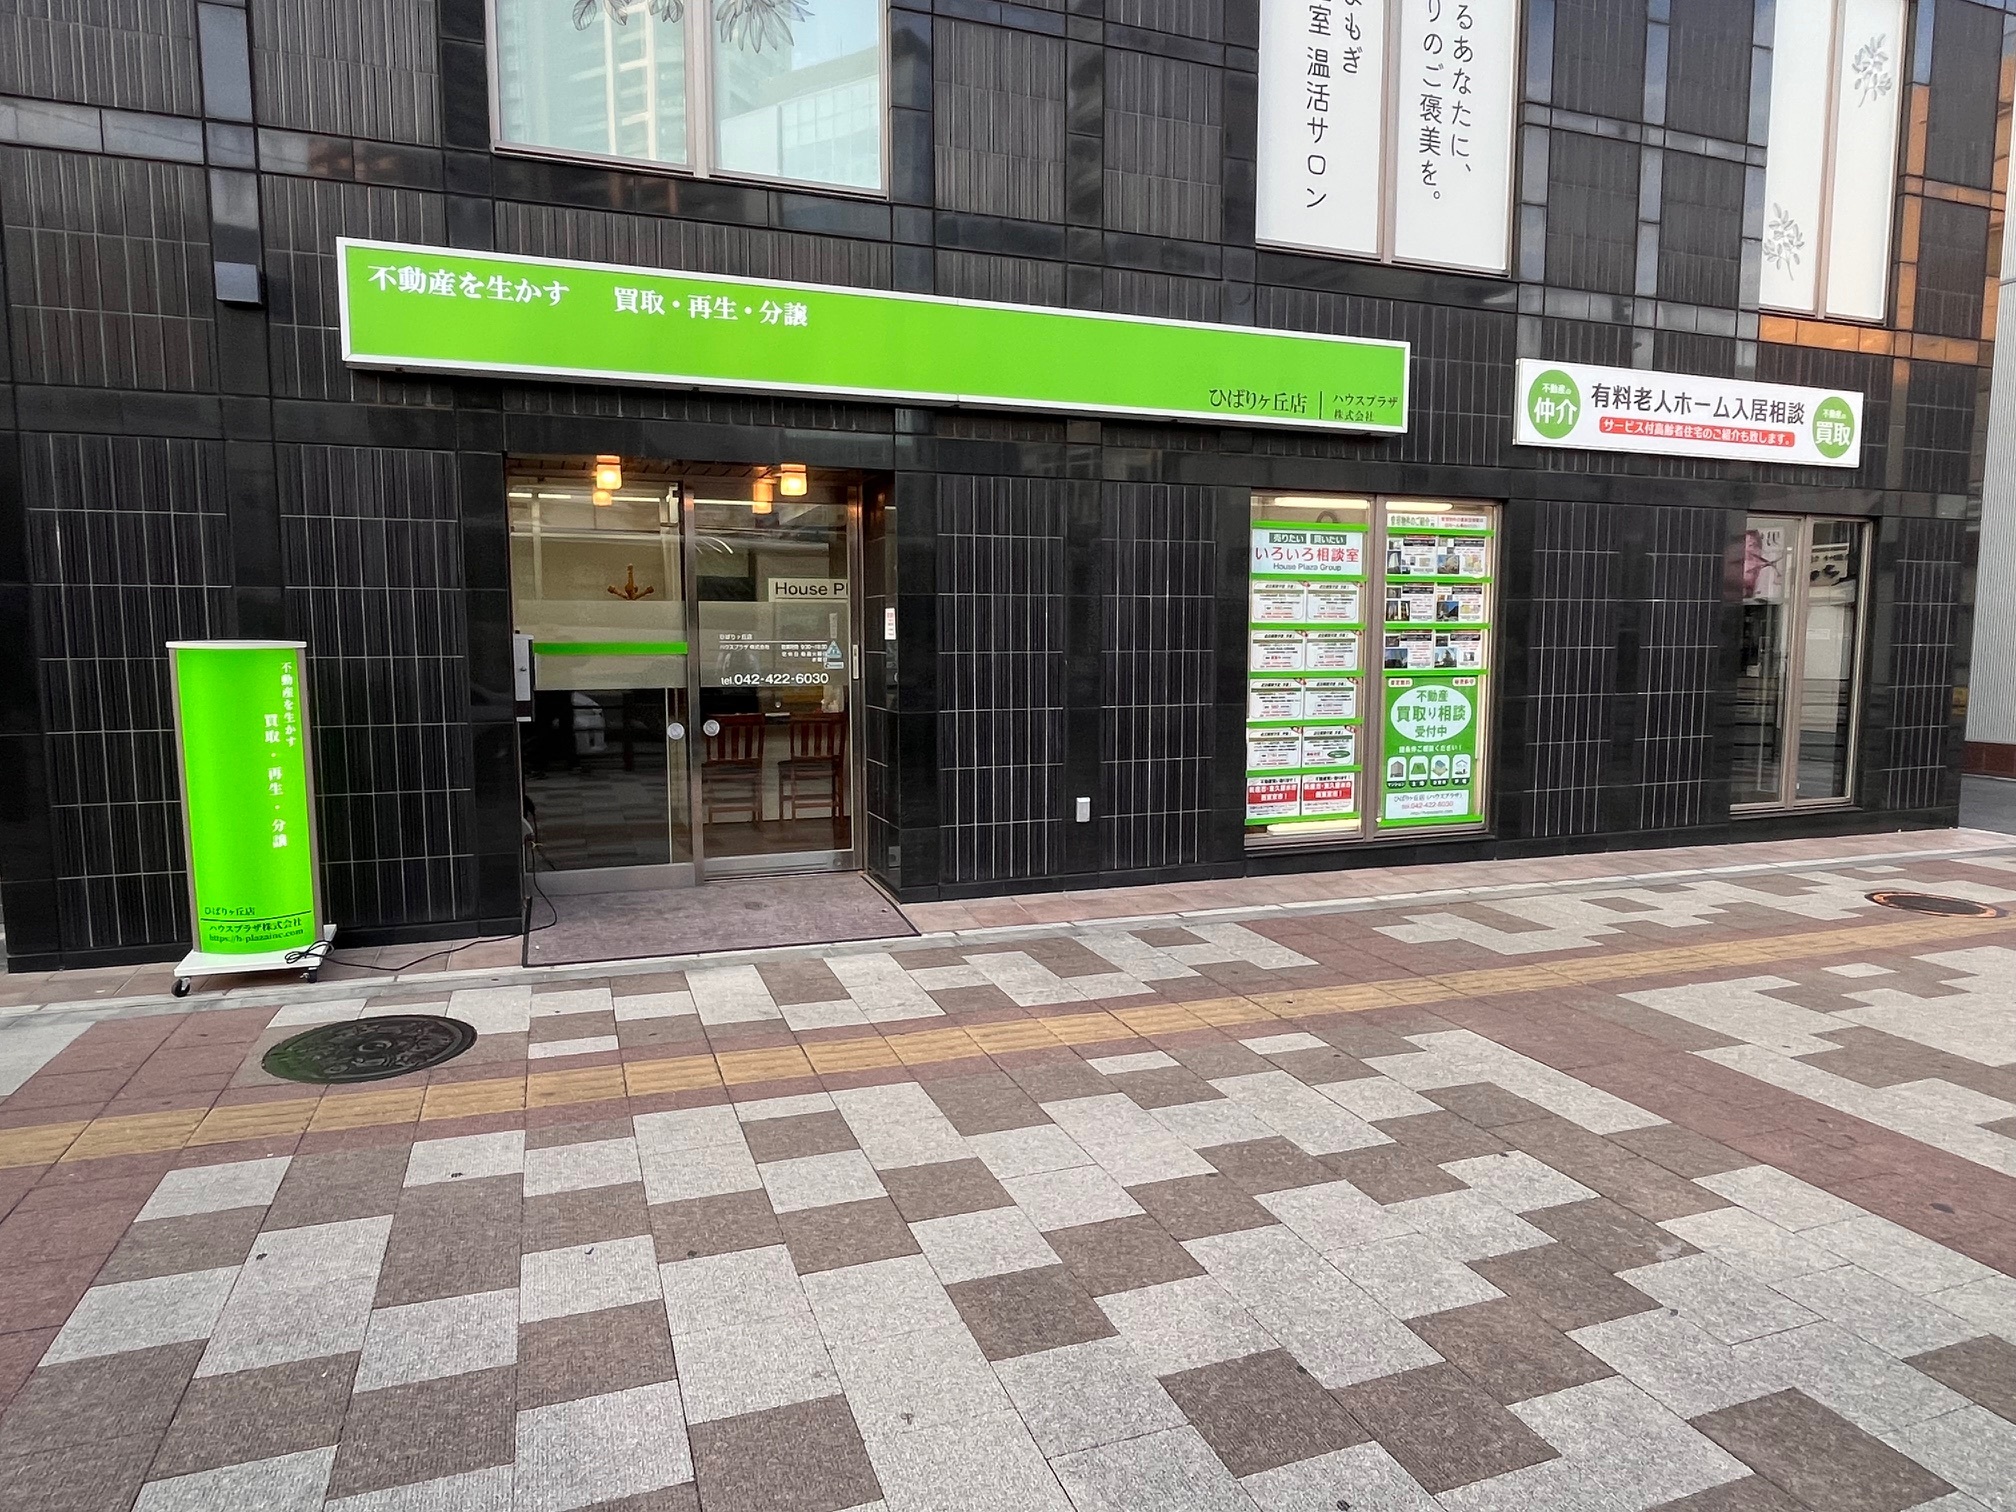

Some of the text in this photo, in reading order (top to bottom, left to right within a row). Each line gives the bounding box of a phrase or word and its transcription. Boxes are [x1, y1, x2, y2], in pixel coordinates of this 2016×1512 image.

[1343, 0, 1363, 74] もぎ
[1451, 4, 1474, 172] るあなたに、
[1419, 0, 1444, 200] りのご褒美を。
[368, 264, 808, 327] 不動産を生かす 買取・再生・分譲
[1333, 393, 1399, 409] ハウスプラザ
[1591, 383, 1805, 425] 有料老人ホーム入居相談
[1334, 409, 1375, 422] 株式会社
[1533, 396, 1578, 426] 仲介
[1815, 421, 1851, 447] 買取
[1273, 533, 1305, 543] 売りたい
[1255, 546, 1360, 563] いろいろ相談室
[1273, 562, 1342, 572] House Plaza Group
[775, 581, 828, 596] House
[280, 661, 296, 747] 不動産を生かす
[1416, 689, 1448, 703] 不動産
[1396, 704, 1466, 722] 買取り相談
[1414, 725, 1448, 738] 受付中
